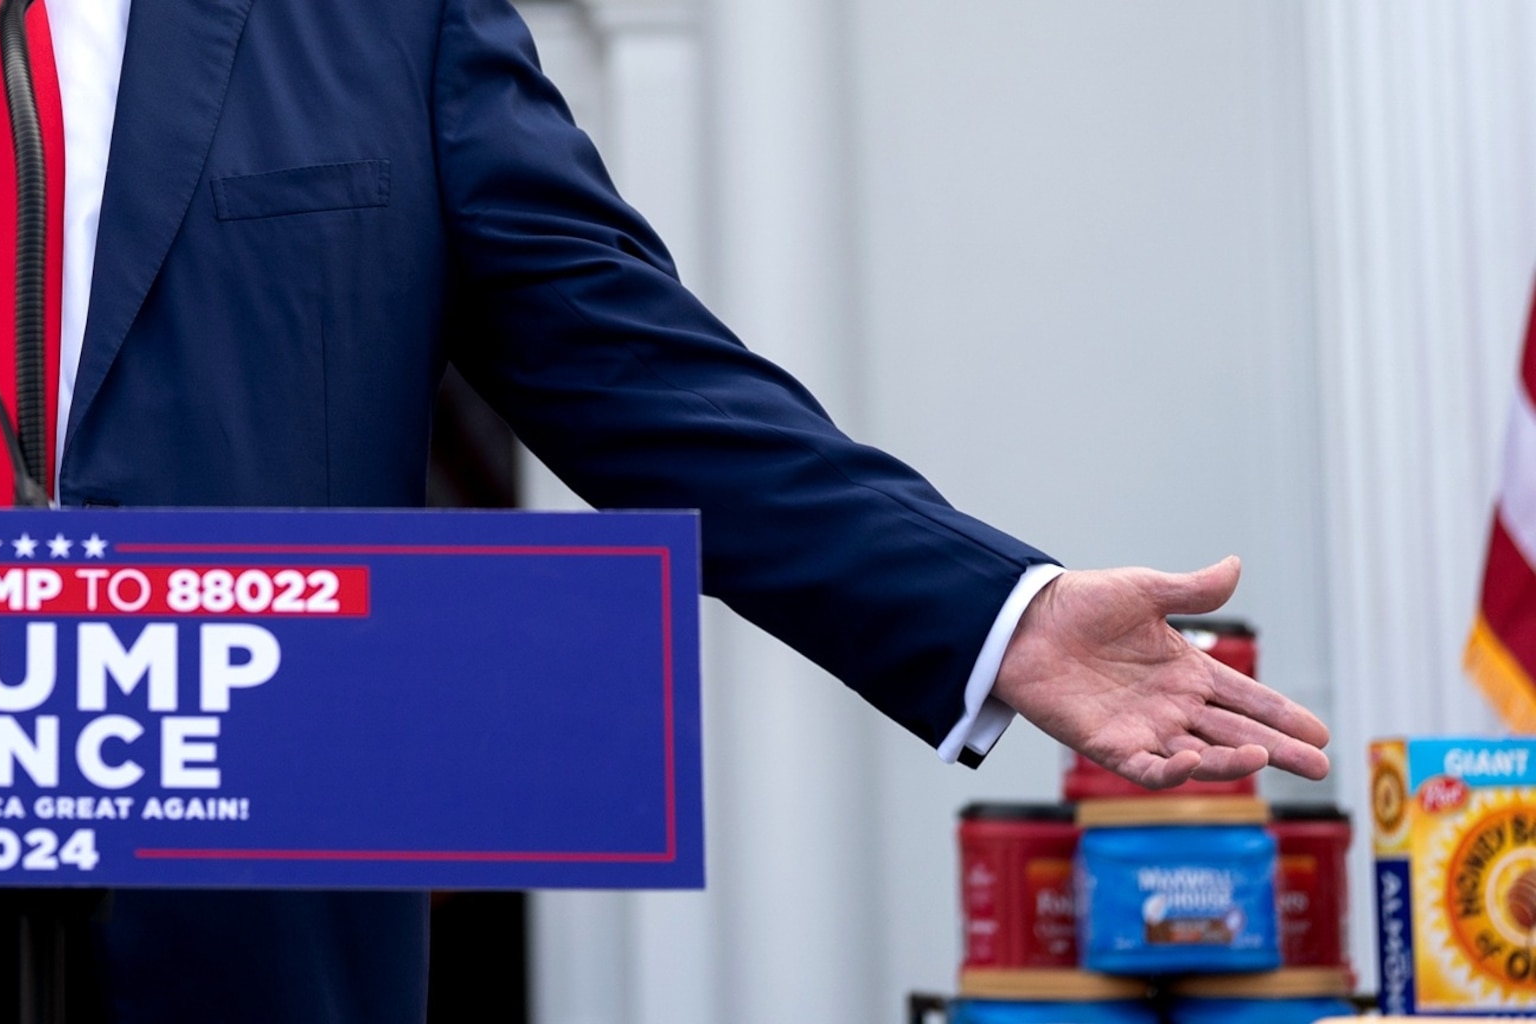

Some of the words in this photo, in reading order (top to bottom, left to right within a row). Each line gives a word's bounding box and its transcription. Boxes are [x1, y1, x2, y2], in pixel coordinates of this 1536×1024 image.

[75, 568, 151, 612] TO
[167, 569, 340, 613] 88022
[1444, 747, 1529, 778] GIANT
[33, 796, 135, 820] GREAT
[141, 797, 251, 821] AGAIN!
